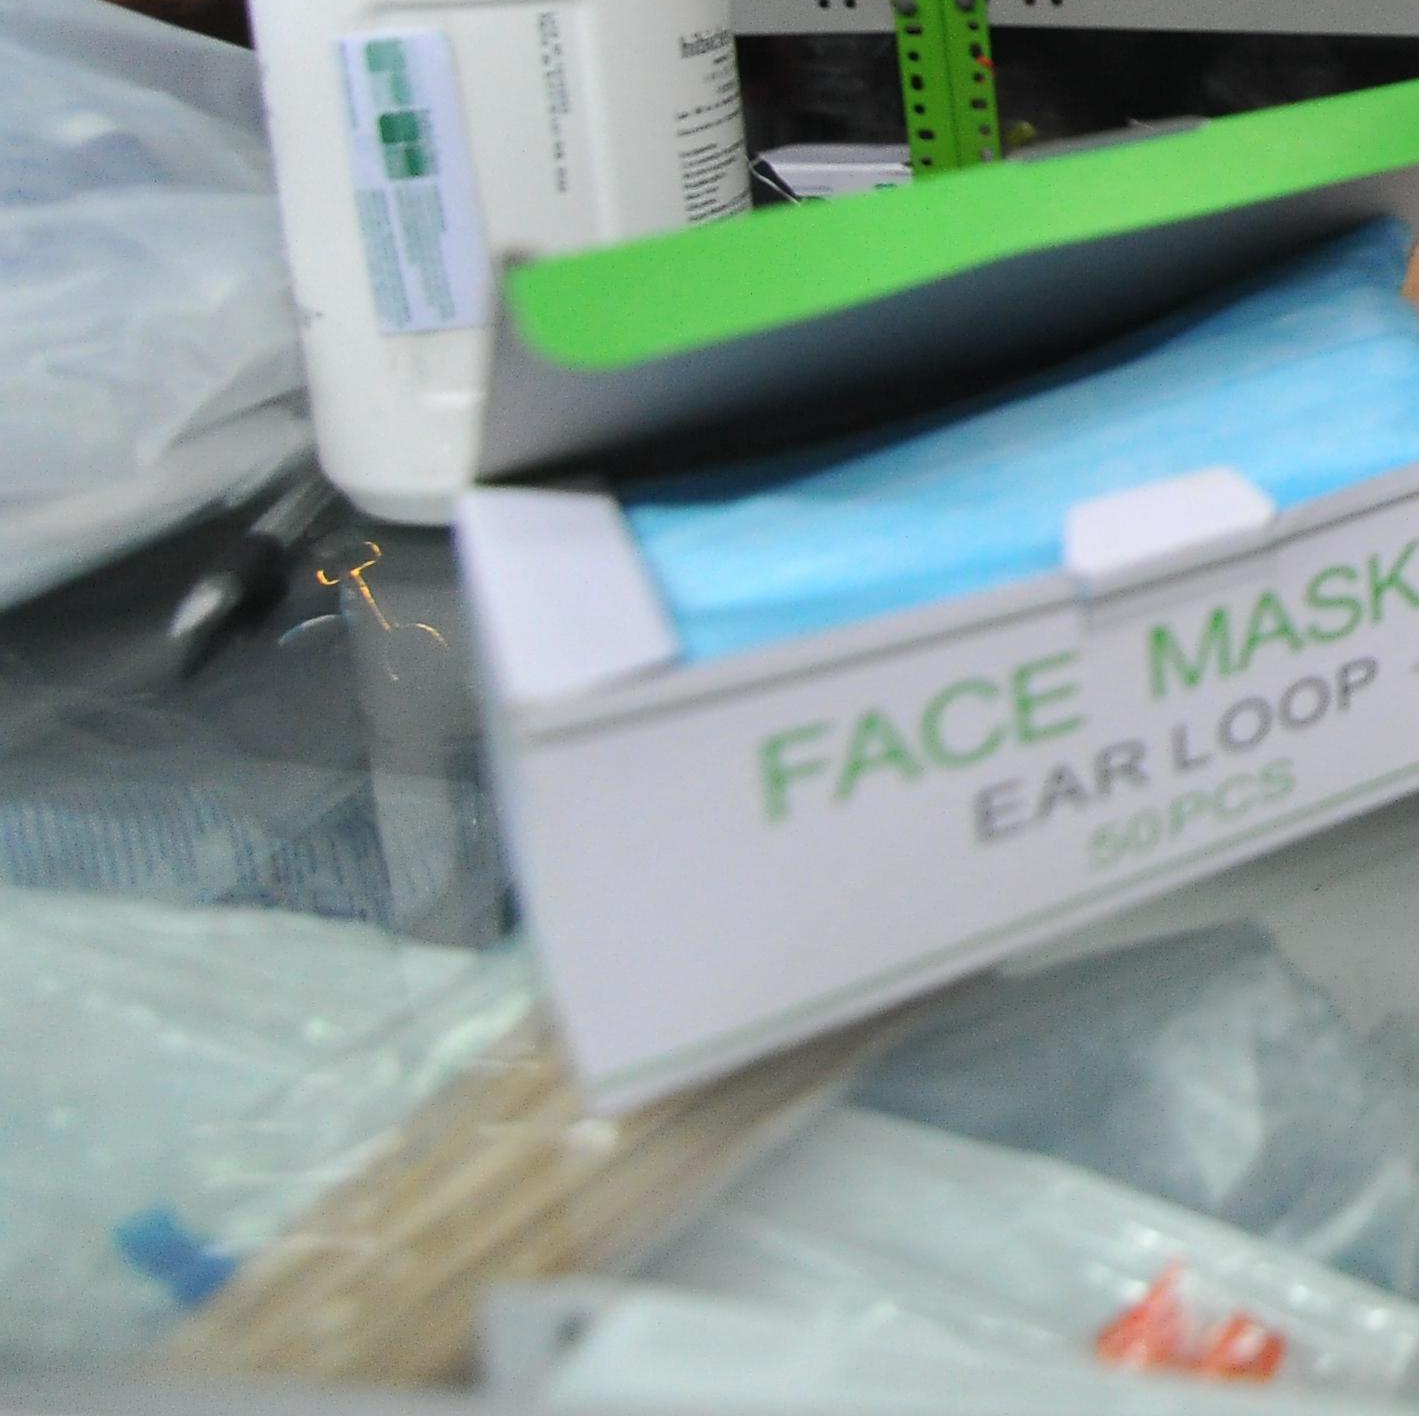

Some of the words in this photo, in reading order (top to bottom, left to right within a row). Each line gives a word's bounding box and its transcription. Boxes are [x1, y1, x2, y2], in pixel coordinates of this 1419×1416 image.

[755, 648, 1088, 826] FACE
[971, 736, 1154, 844] EAR
[1172, 655, 1382, 773] LOOP
